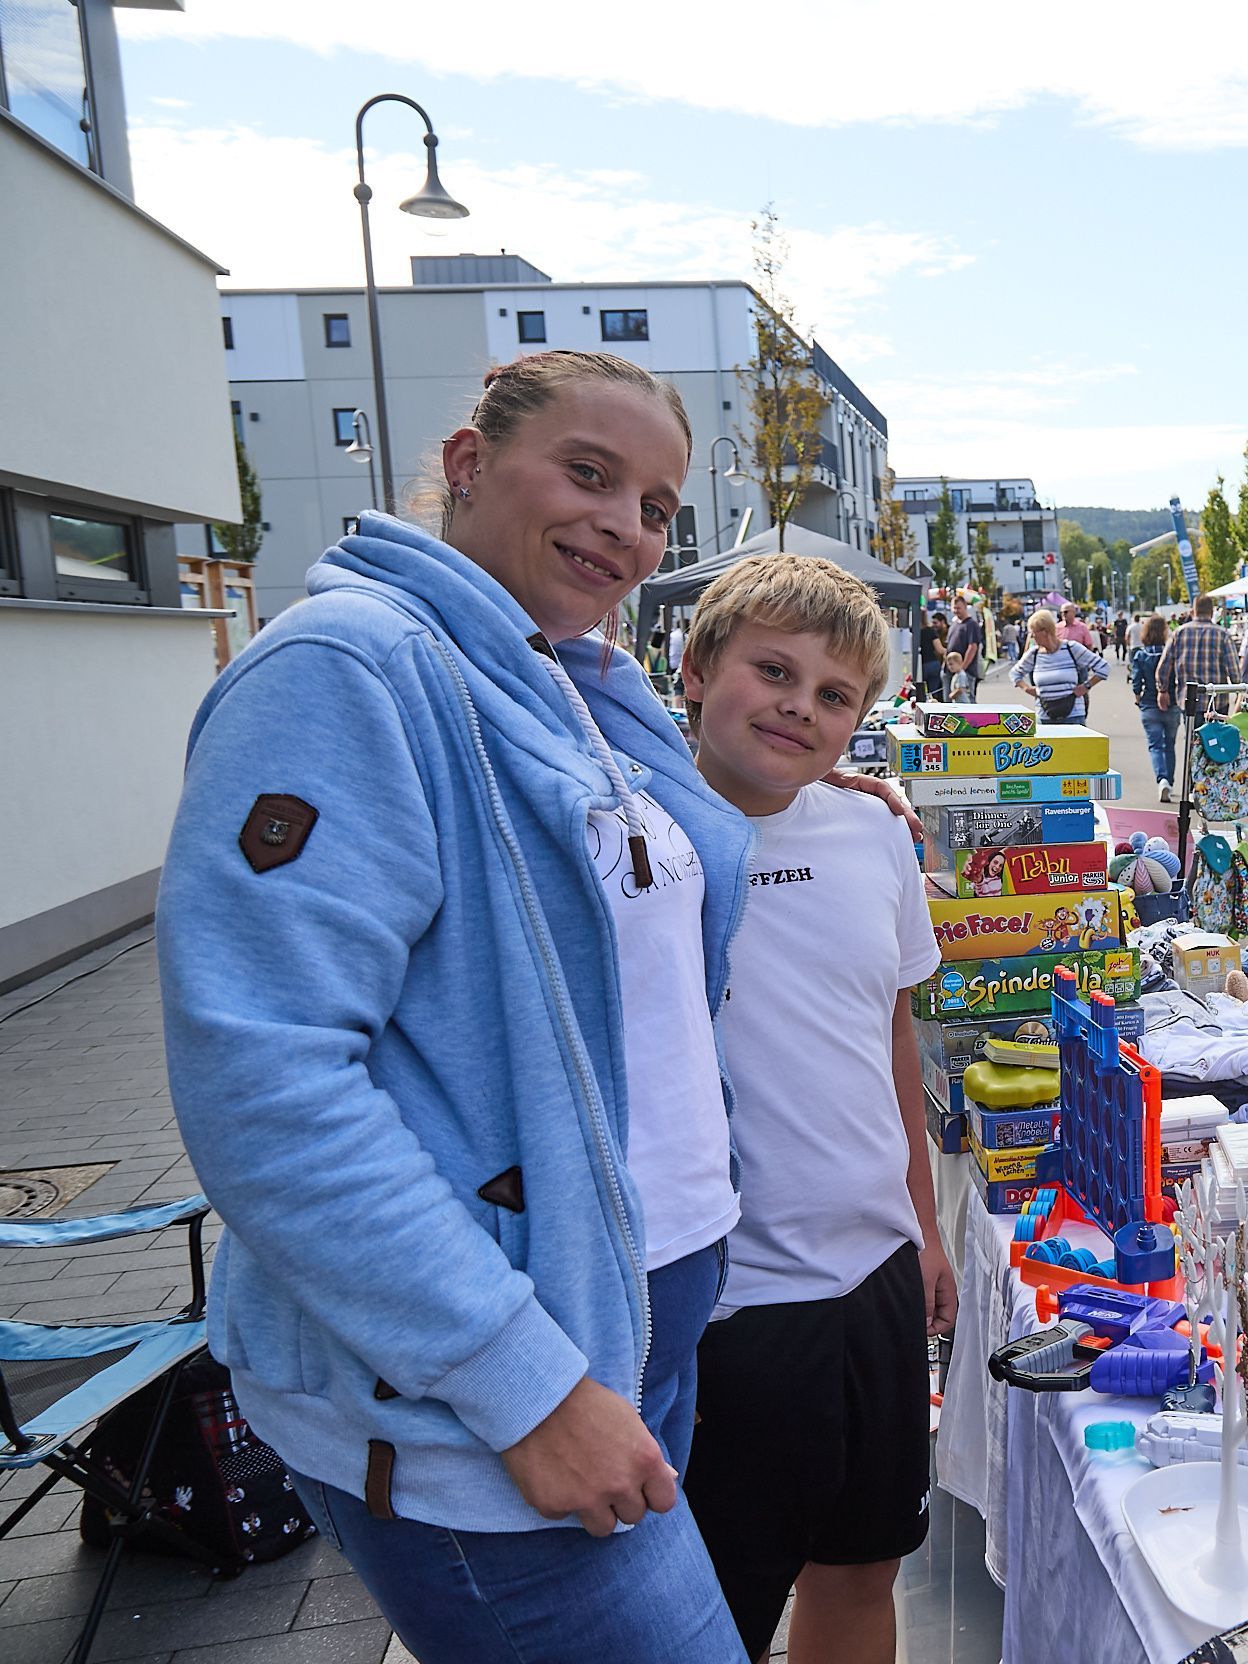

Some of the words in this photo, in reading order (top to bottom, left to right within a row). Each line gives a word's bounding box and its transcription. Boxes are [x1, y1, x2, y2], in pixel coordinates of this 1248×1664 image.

[992, 741, 1053, 772] Bingo
[934, 787, 968, 796] spielend
[972, 812, 1009, 820] Dinner
[1044, 806, 1091, 816] Ravensburger
[993, 820, 1013, 828] One
[1011, 850, 1070, 882] Tabu
[1050, 873, 1079, 884] Junior
[964, 911, 1034, 938] Face!
